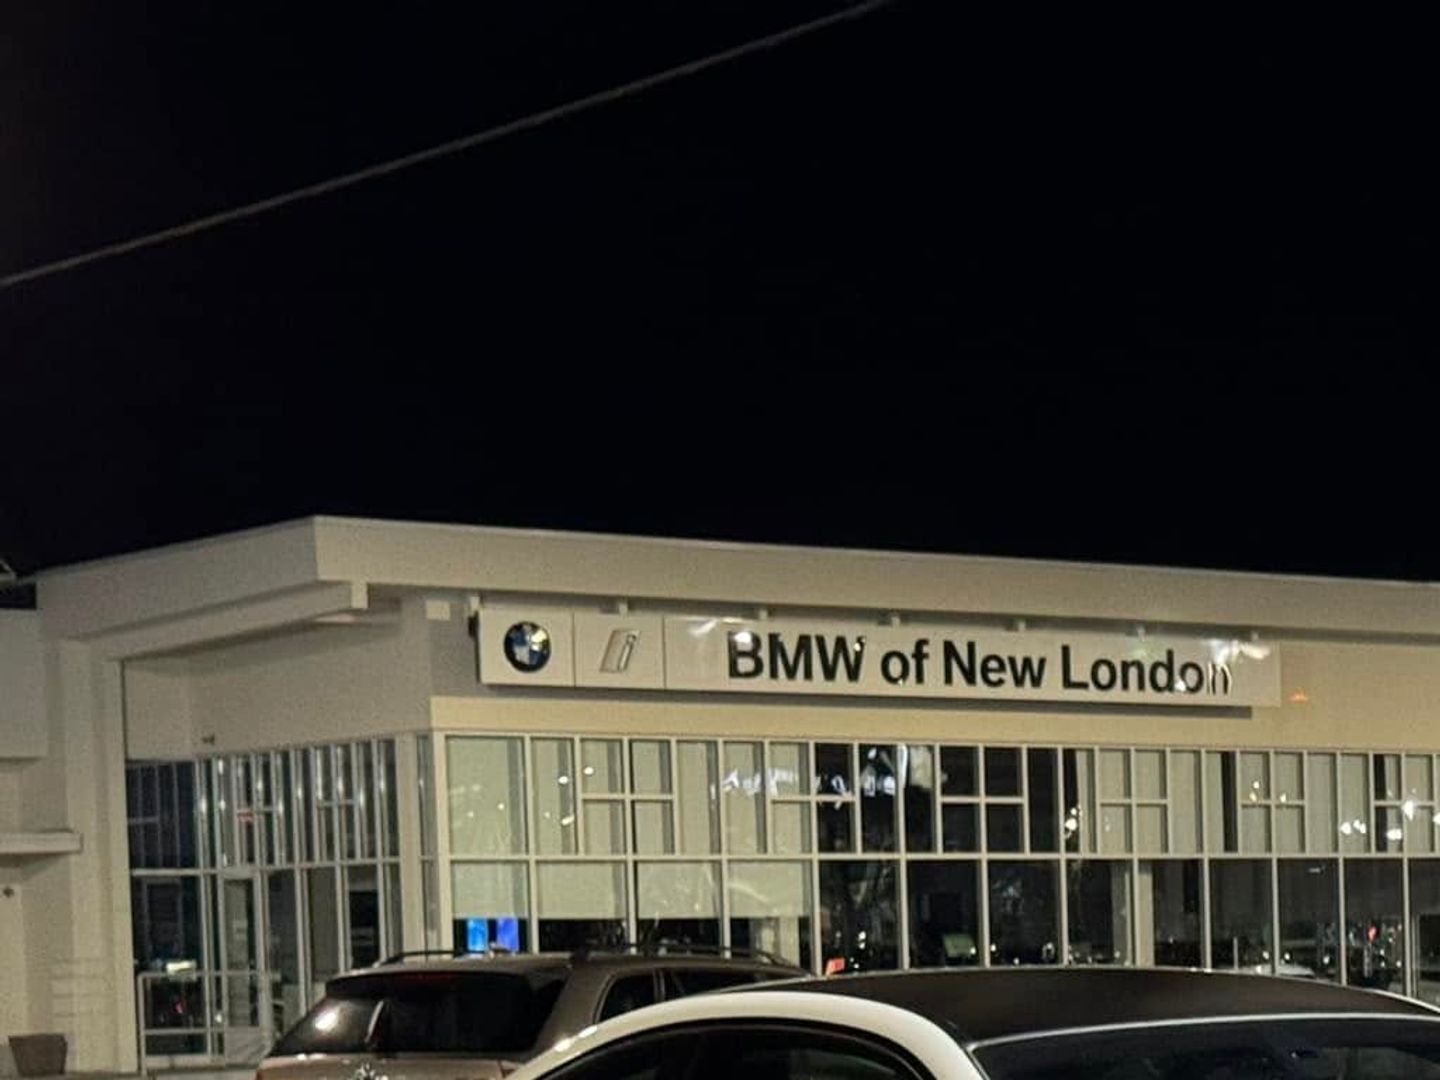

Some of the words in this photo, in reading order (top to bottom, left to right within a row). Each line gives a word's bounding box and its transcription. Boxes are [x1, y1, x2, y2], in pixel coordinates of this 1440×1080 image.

[729, 631, 866, 682] BMW
[881, 639, 928, 684] of
[944, 640, 1046, 688] New
[1061, 645, 1231, 695] London
